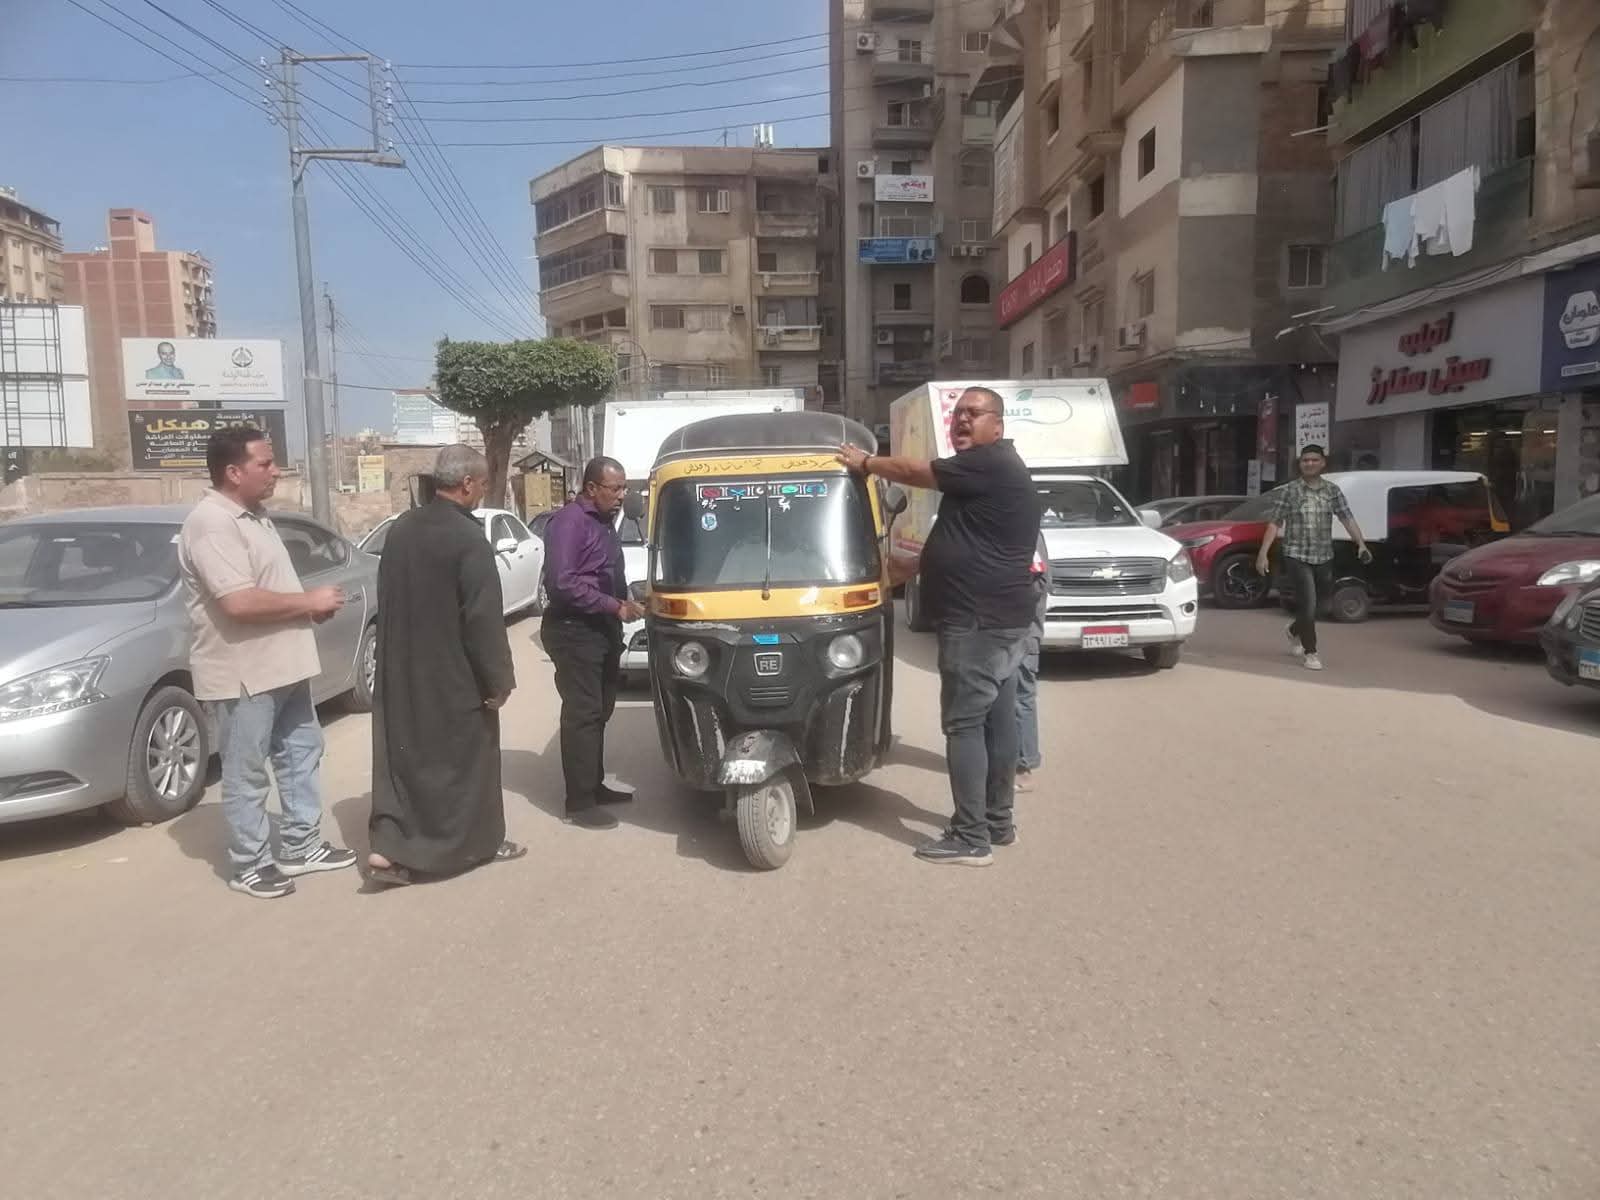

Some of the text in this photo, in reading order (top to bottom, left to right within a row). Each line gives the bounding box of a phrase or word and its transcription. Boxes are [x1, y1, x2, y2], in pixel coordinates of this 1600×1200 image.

[1367, 364, 1428, 405] ستارز
[146, 418, 211, 434] هيكل
[760, 660, 778, 670] RE
